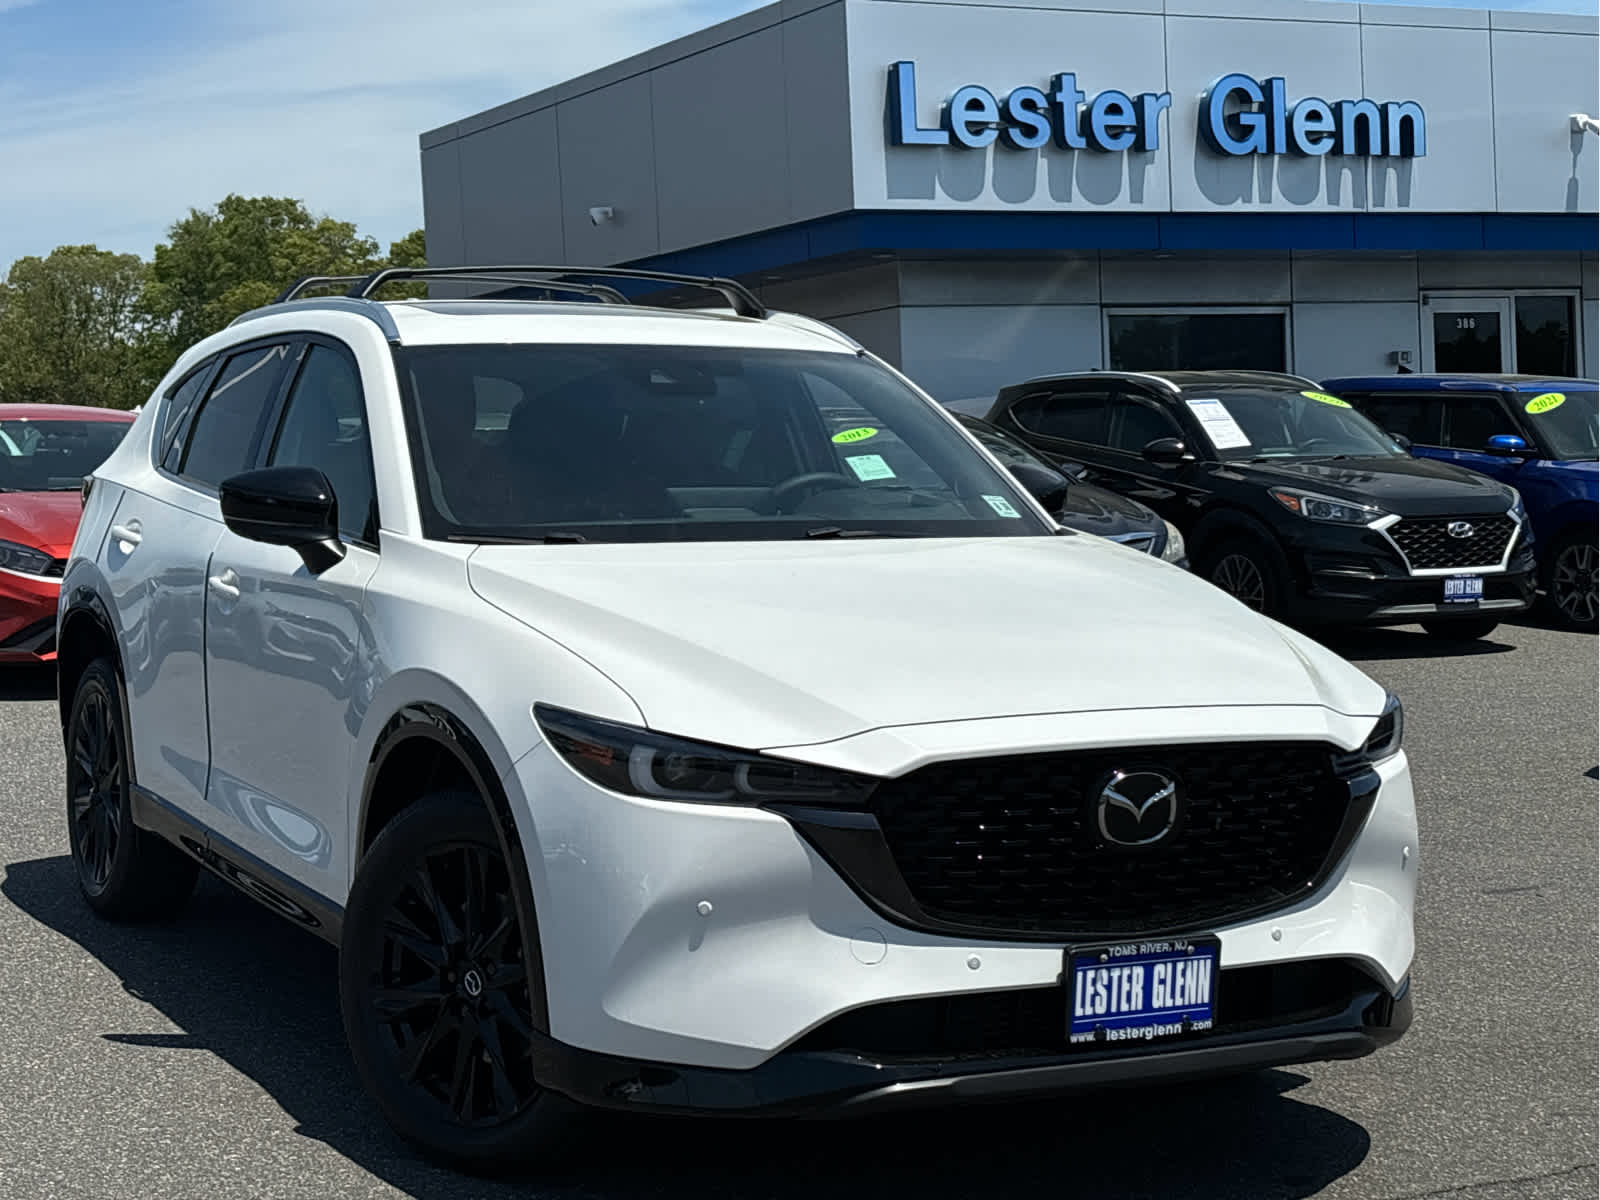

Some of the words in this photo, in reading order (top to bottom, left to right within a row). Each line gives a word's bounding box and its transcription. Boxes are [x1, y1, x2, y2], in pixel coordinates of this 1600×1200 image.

[888, 60, 1171, 154] Lester
[1201, 72, 1427, 158] Glenn
[1456, 318, 1476, 329] 386
[1532, 394, 1559, 412] 2021
[1107, 944, 1138, 958] TOMS
[1174, 940, 1189, 951] NJ
[1074, 965, 1145, 1017] LESTER
[1152, 958, 1212, 1009] GLENN
